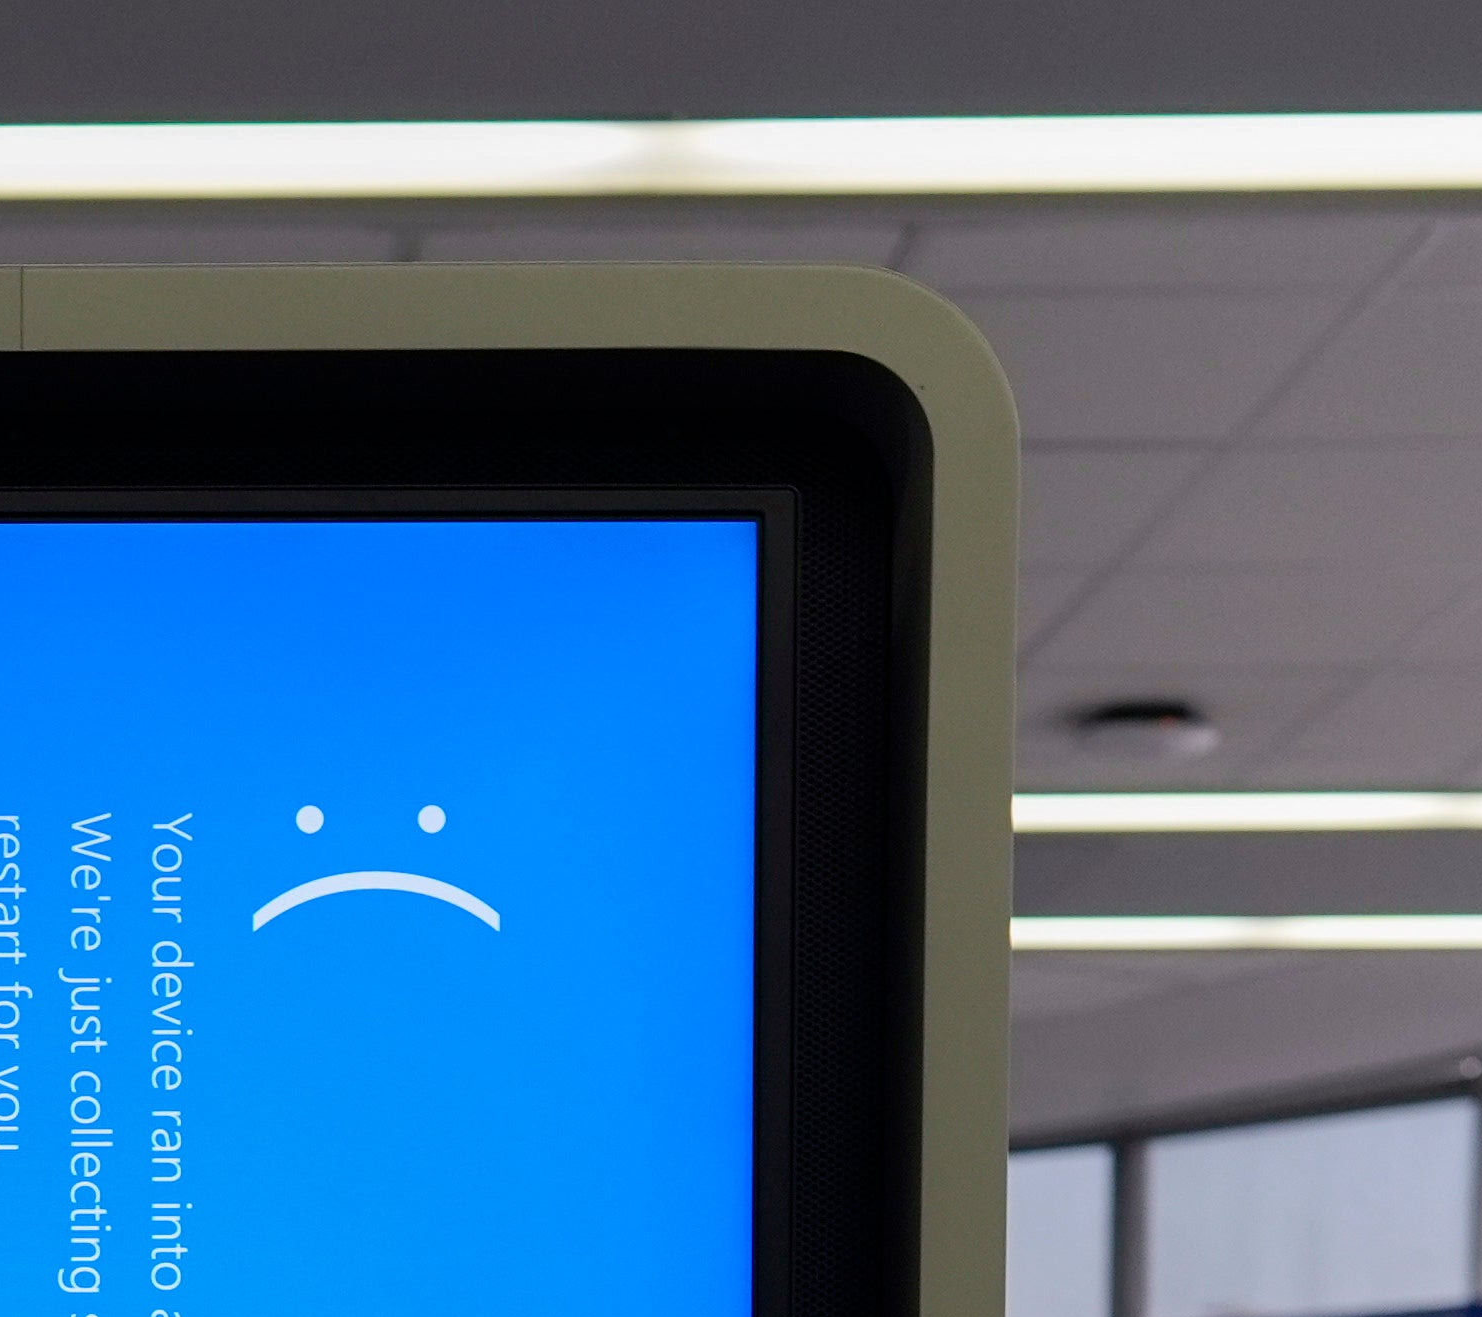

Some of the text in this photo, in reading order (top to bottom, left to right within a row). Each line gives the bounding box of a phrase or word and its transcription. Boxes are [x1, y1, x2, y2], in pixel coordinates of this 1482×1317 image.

[70, 812, 112, 952] We're
[151, 812, 193, 924] Your
[57, 967, 113, 1054] just
[151, 940, 195, 1091] device
[57, 1070, 114, 1294] collecting
[150, 1110, 182, 1182] ran
[150, 1202, 193, 1291] into
